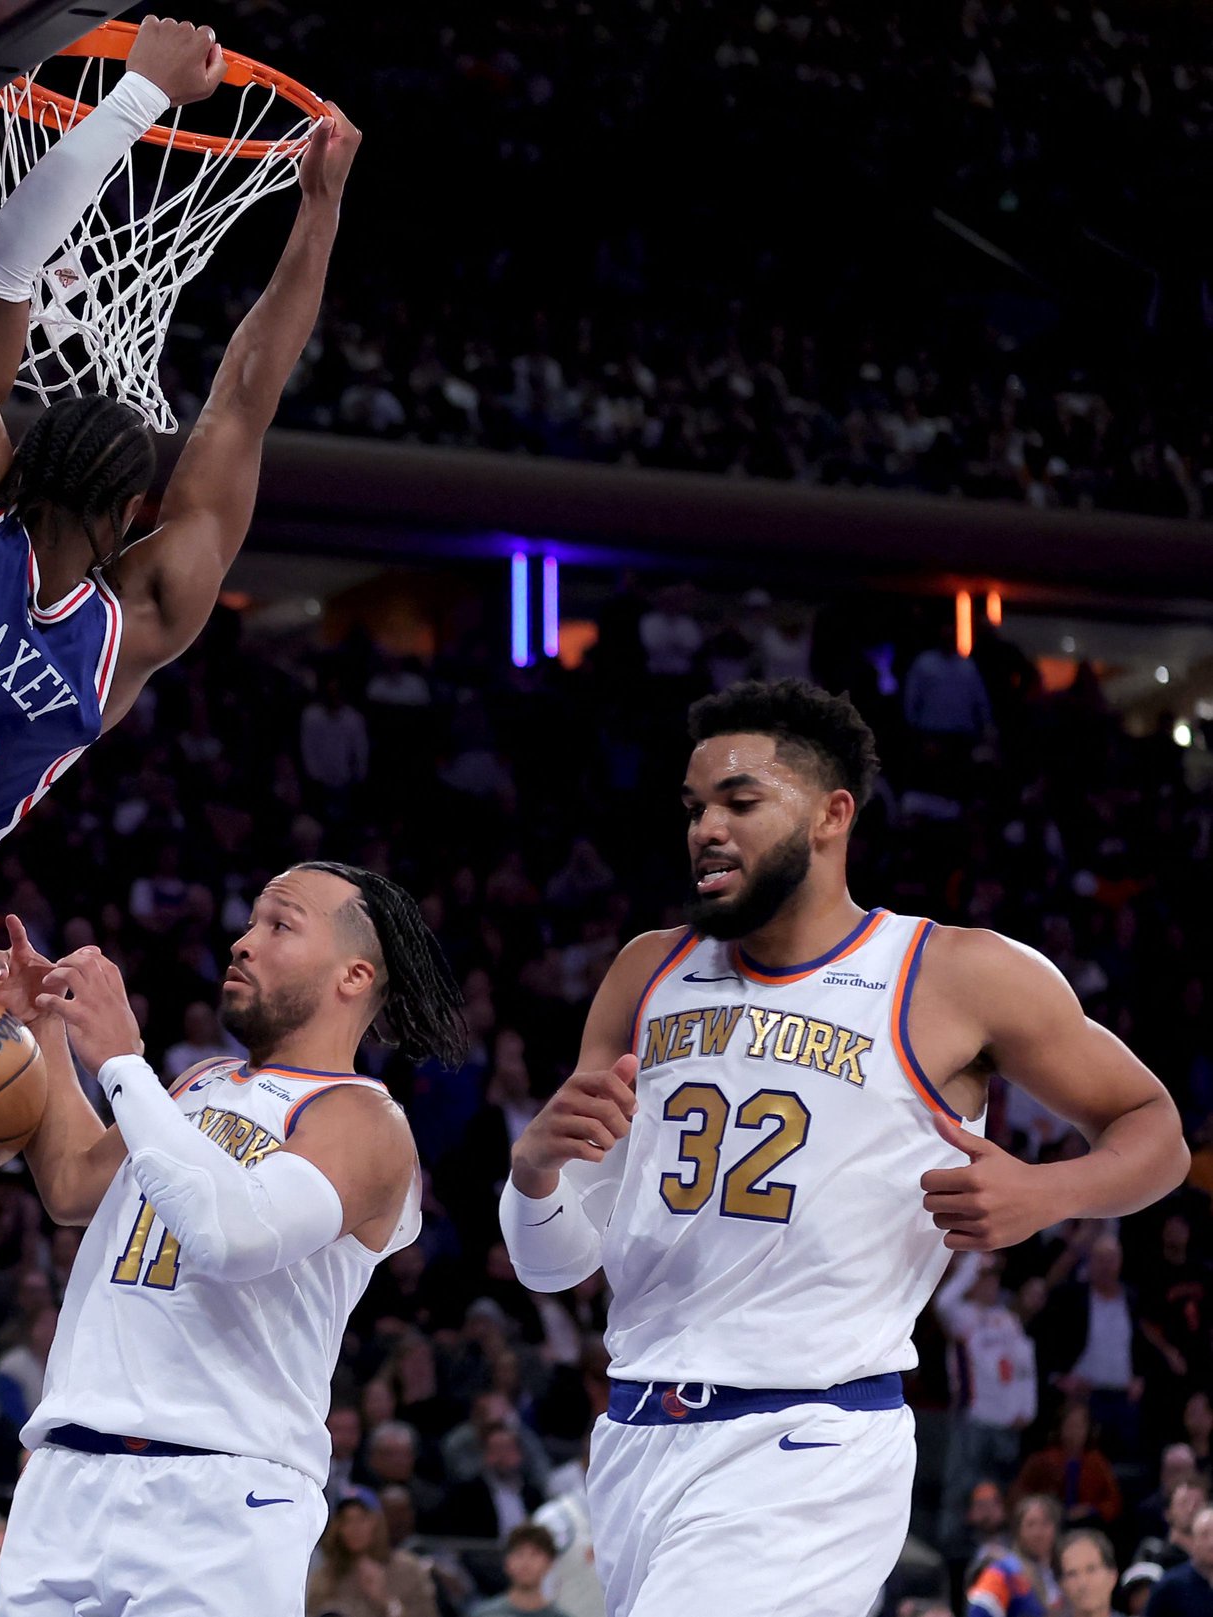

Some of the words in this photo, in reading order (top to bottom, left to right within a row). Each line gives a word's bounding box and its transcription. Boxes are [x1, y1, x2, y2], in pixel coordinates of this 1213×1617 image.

[823, 976, 848, 986] abu
[849, 977, 888, 991] dhabi
[640, 1003, 747, 1073] NEW
[744, 1003, 874, 1089] YORK
[659, 1082, 812, 1225] 32
[110, 1192, 181, 1290] 11
